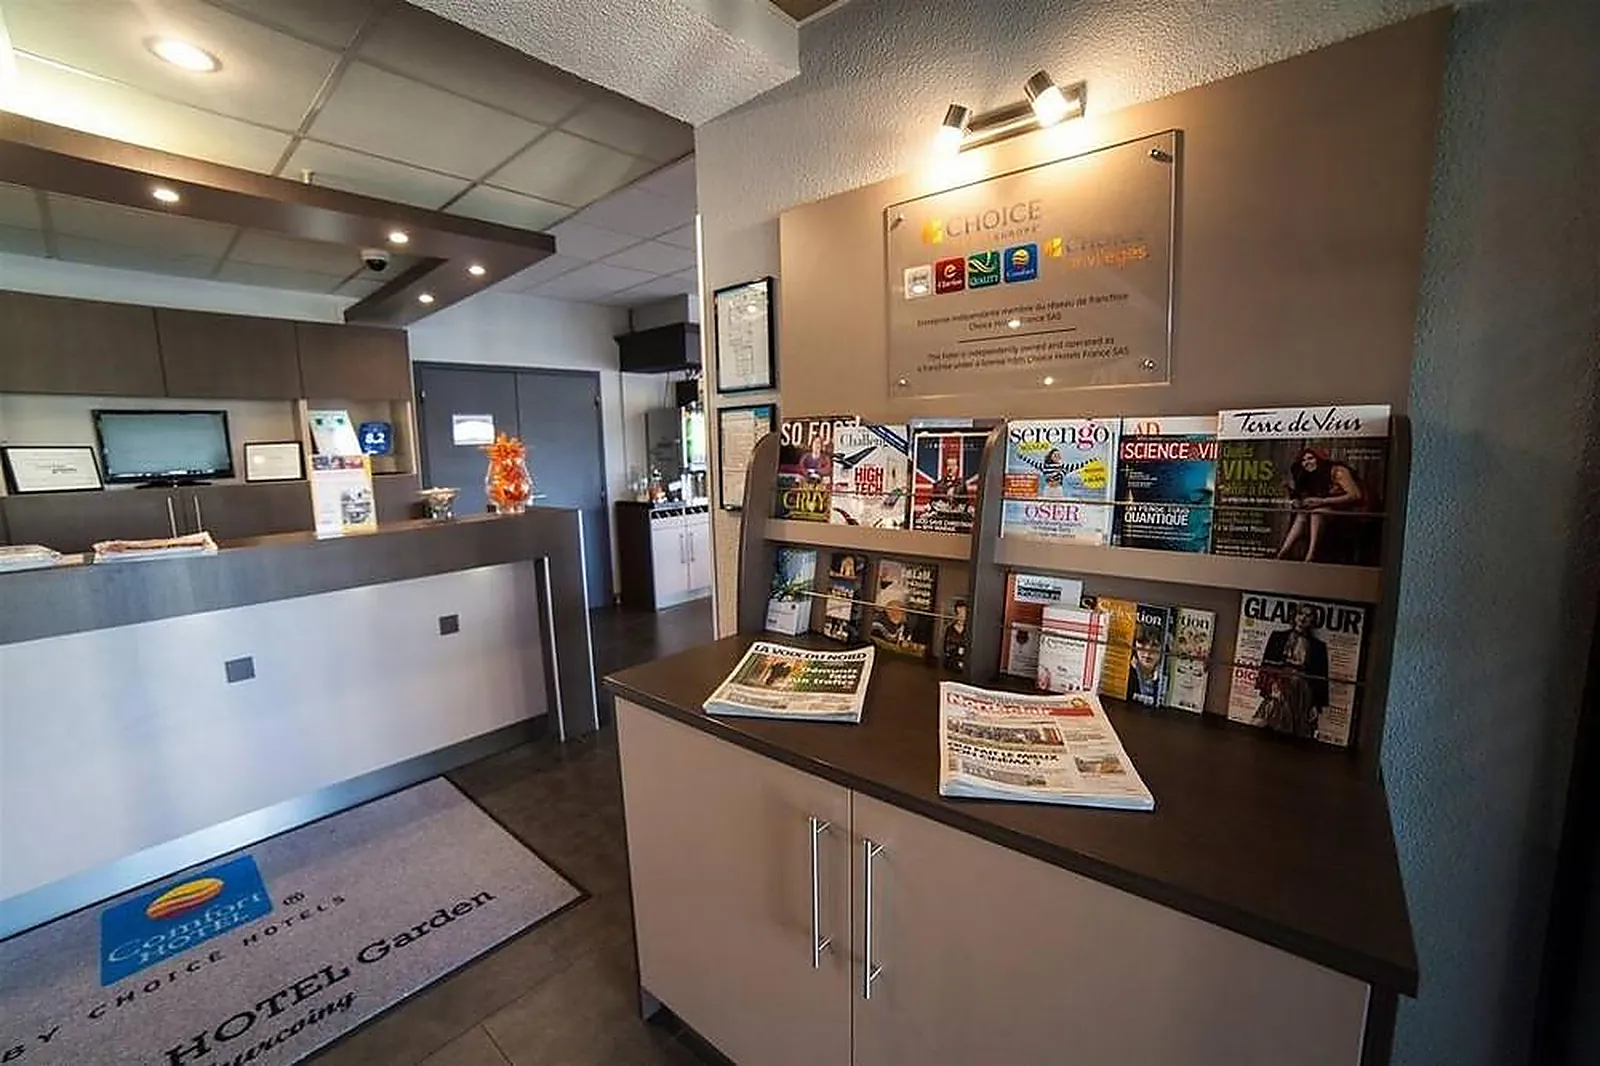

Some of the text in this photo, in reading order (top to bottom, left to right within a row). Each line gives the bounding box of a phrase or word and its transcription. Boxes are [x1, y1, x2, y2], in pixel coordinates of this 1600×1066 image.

[946, 201, 1041, 237] CHOICE
[1048, 340, 1063, 350] and
[1113, 345, 1129, 355] SAS
[1233, 406, 1362, 433] Terre de Vins
[780, 421, 803, 446] SO
[1009, 422, 1109, 450] serengo
[1123, 442, 1189, 460] SCIENCE
[1198, 443, 1219, 460] VI
[854, 466, 885, 483] HIGH
[1222, 459, 1276, 481] VINS
[854, 482, 885, 497] TECH
[1024, 502, 1081, 522] OSER
[1124, 511, 1189, 528] QUANTIQUE
[755, 645, 769, 653] LA
[770, 647, 802, 659] VOIX
[108, 893, 263, 963] Comfort
[138, 912, 252, 965] HOTEL
[2, 895, 347, 1064] BY CHOICE HOTELS
[164, 889, 498, 1066] HOTEL Garden
